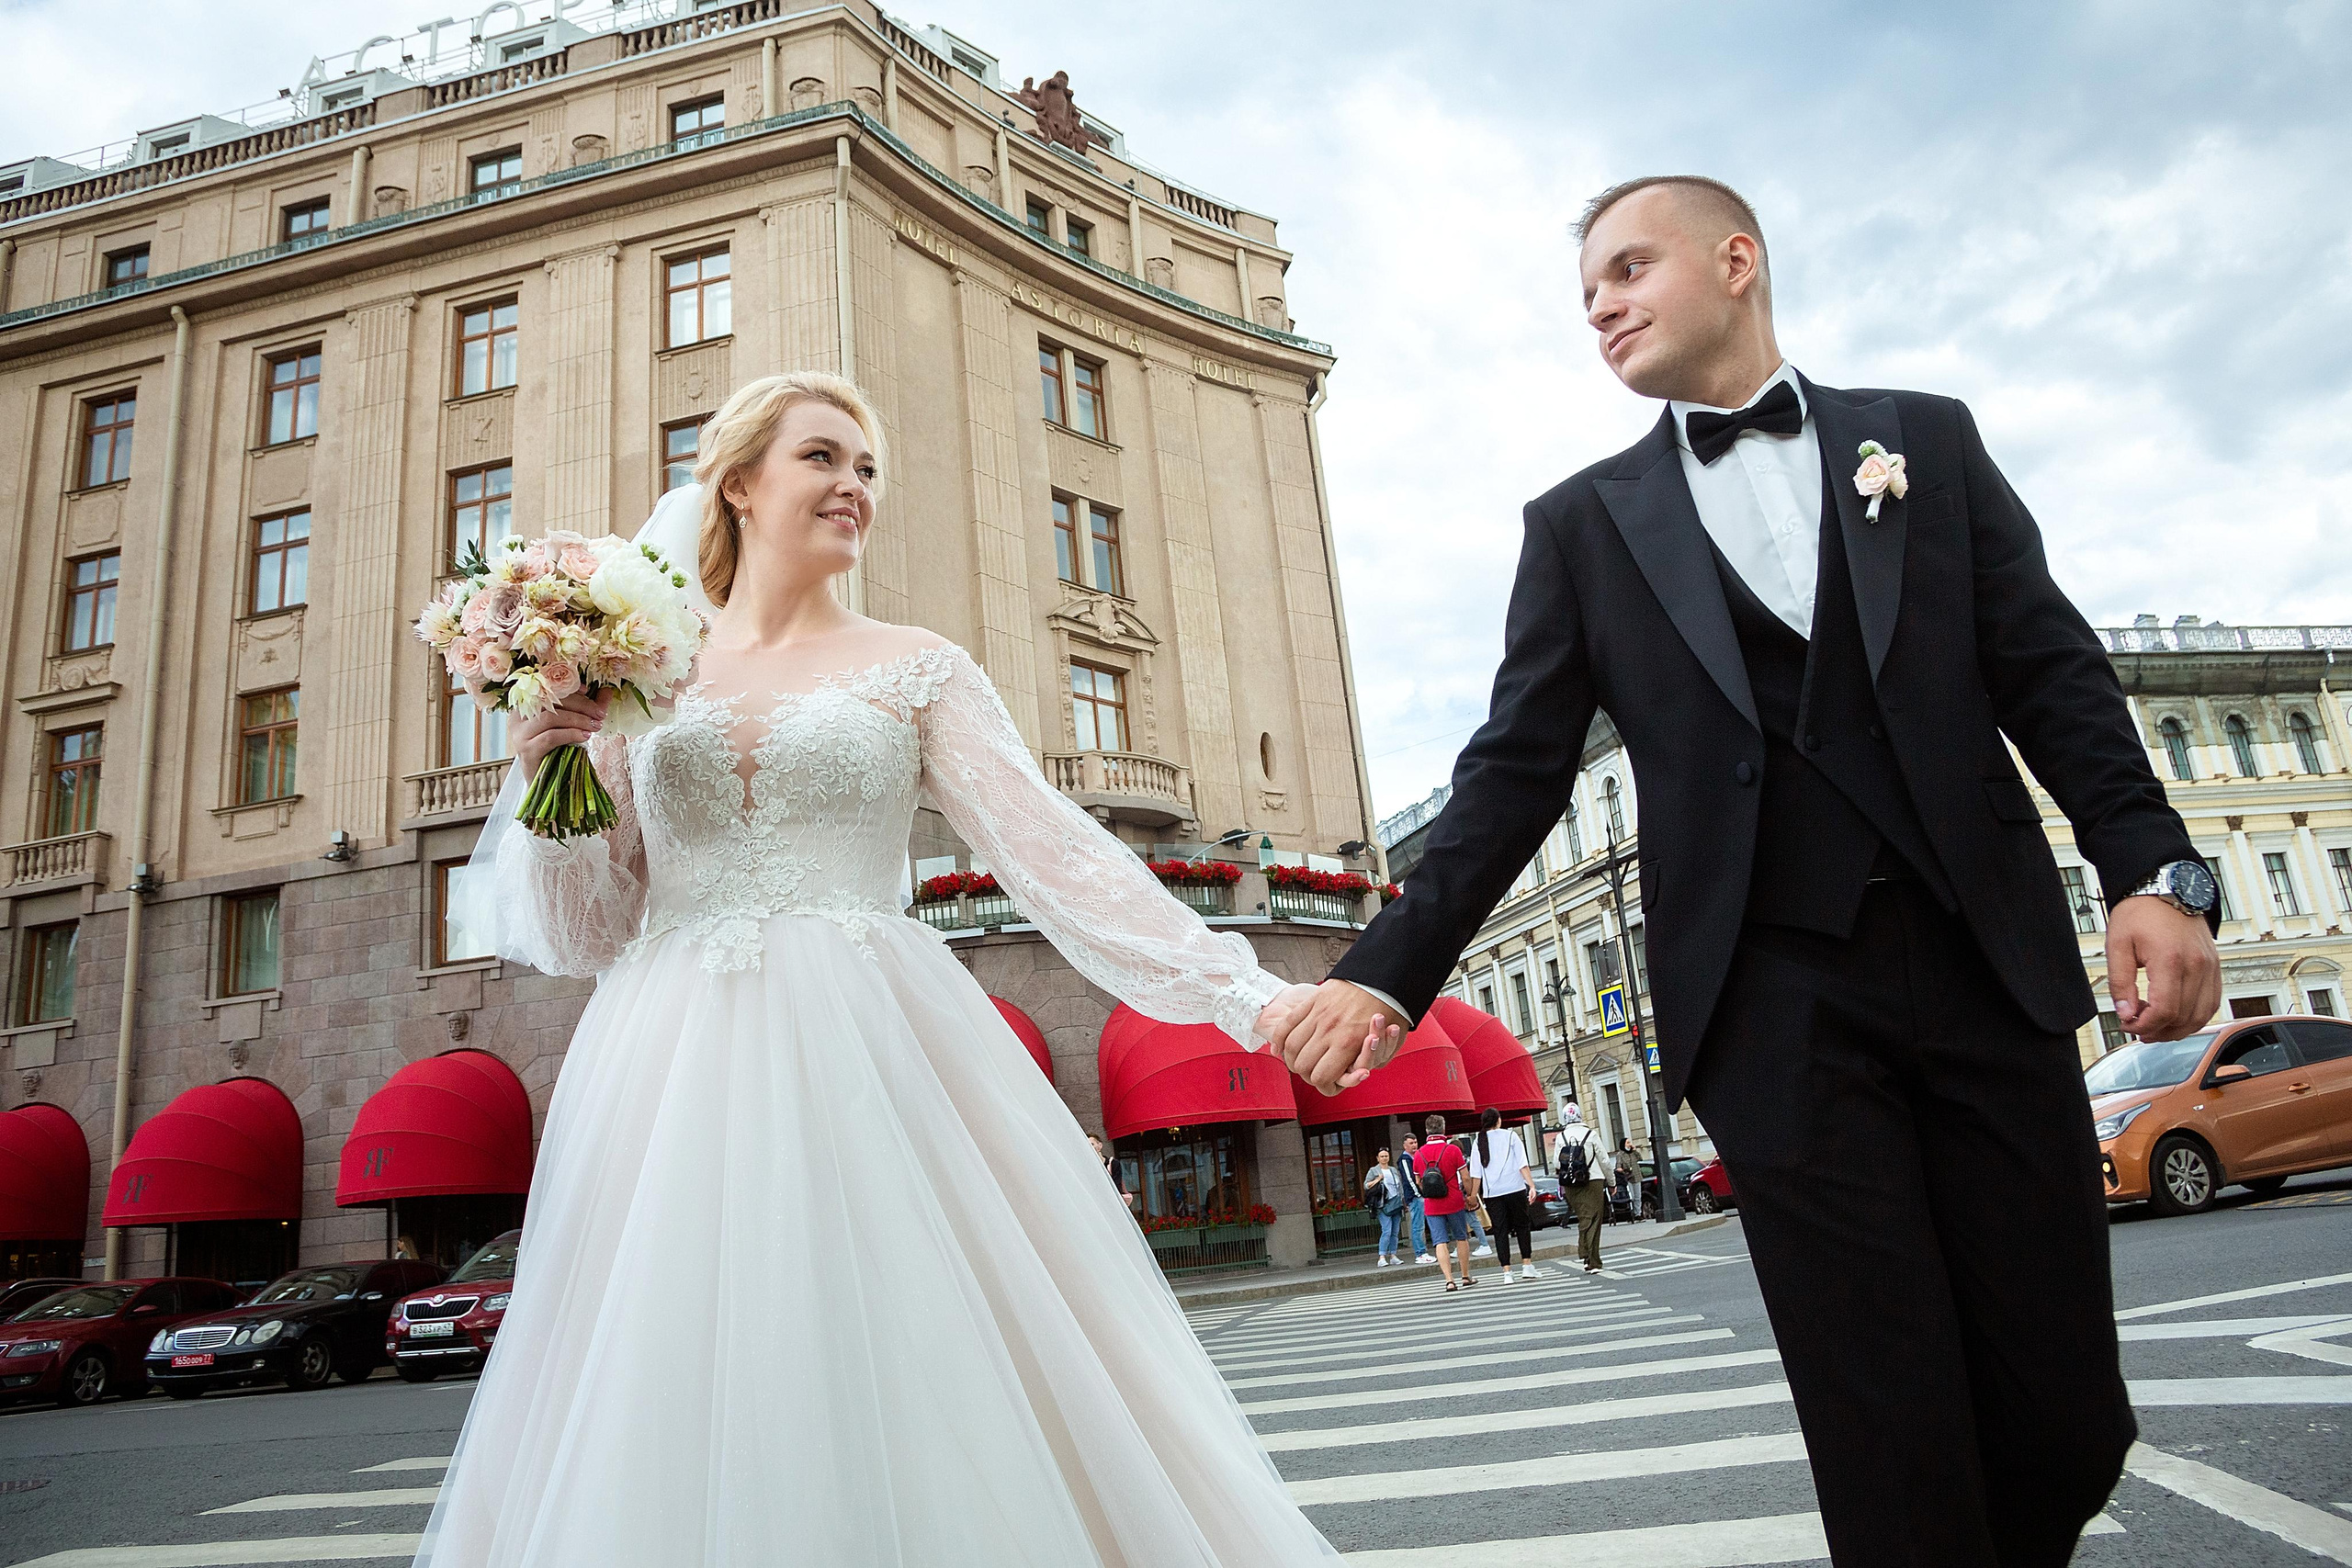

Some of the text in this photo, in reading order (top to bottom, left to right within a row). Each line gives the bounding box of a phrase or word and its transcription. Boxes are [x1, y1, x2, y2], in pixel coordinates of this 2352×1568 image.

[895, 210, 958, 265] HOTEL
[1011, 282, 1142, 354] ASTORIA
[1193, 358, 1256, 389] HOTEL
